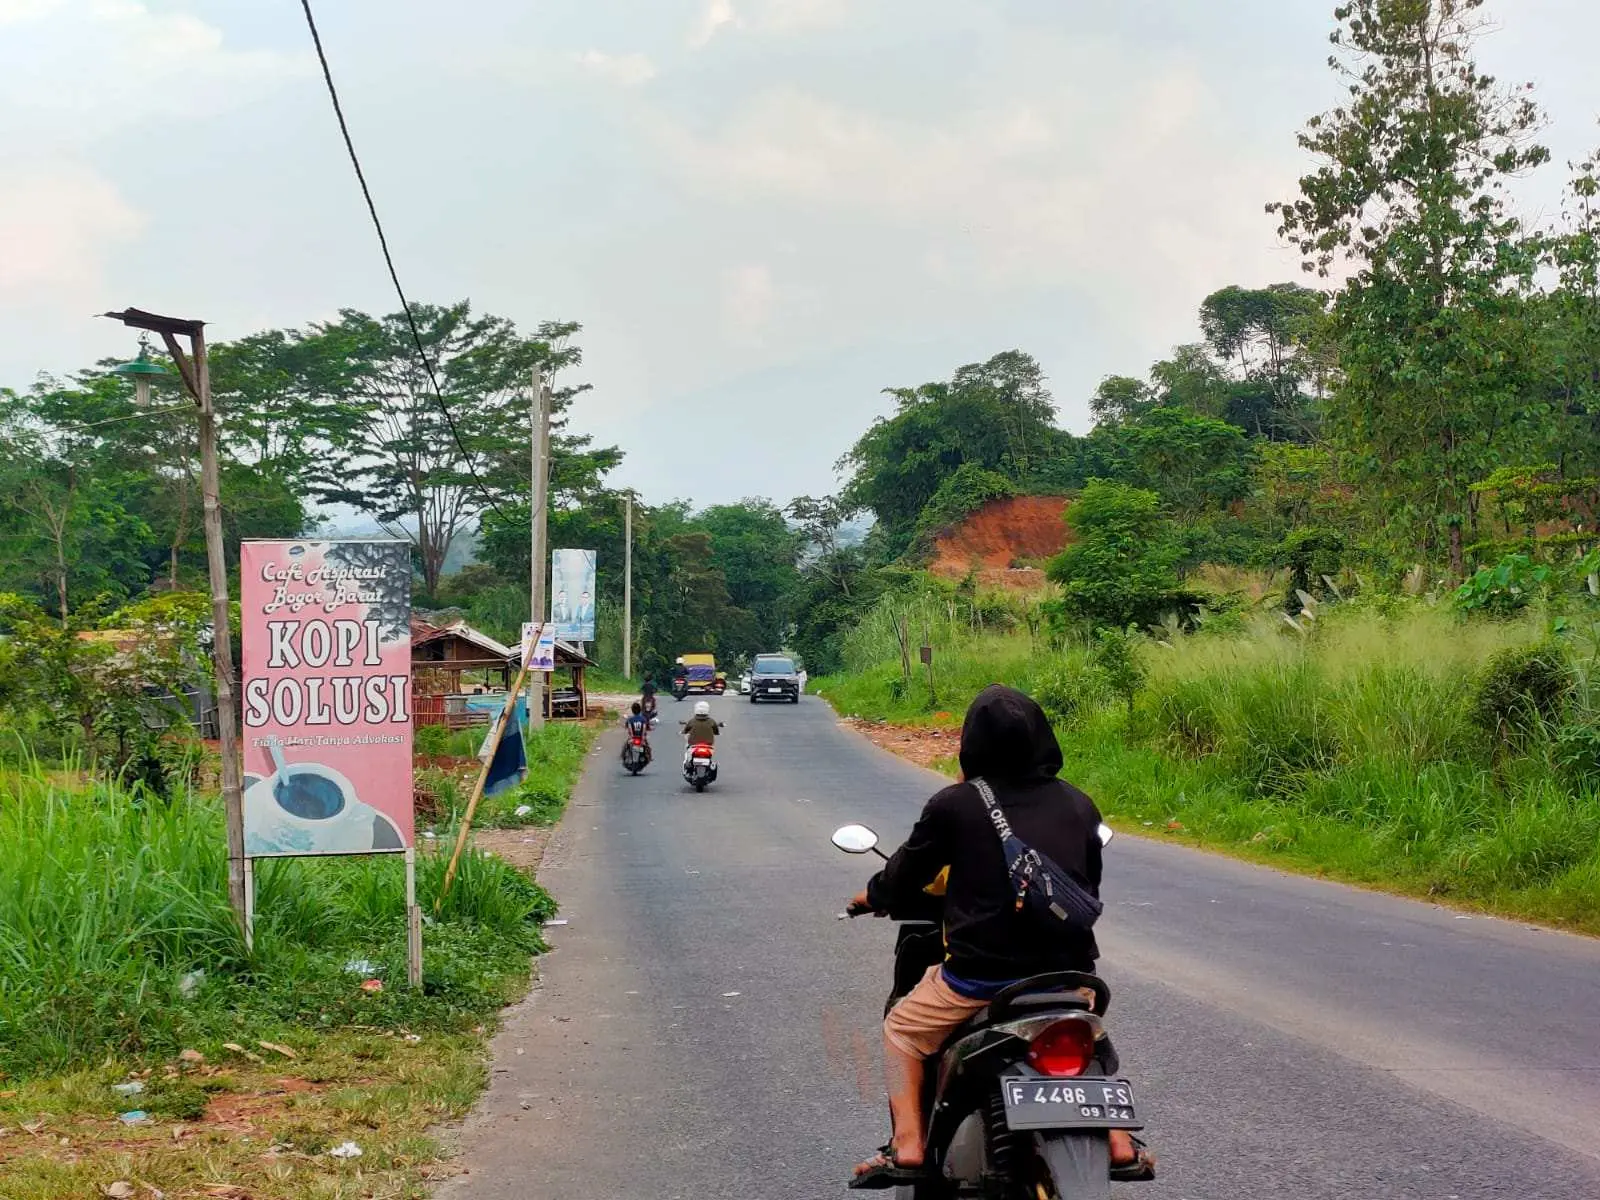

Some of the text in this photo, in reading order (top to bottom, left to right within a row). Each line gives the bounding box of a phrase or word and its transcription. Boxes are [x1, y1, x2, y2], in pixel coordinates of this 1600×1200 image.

[263, 586, 384, 614] Bogor Barat
[267, 619, 382, 669] KOPI
[246, 675, 409, 727] SOLUSI
[315, 735, 351, 746] Tanpa
[352, 733, 404, 744] Advokasi
[1012, 1087, 1129, 1105] F 4486 FS
[1080, 1107, 1129, 1119] 09 24
